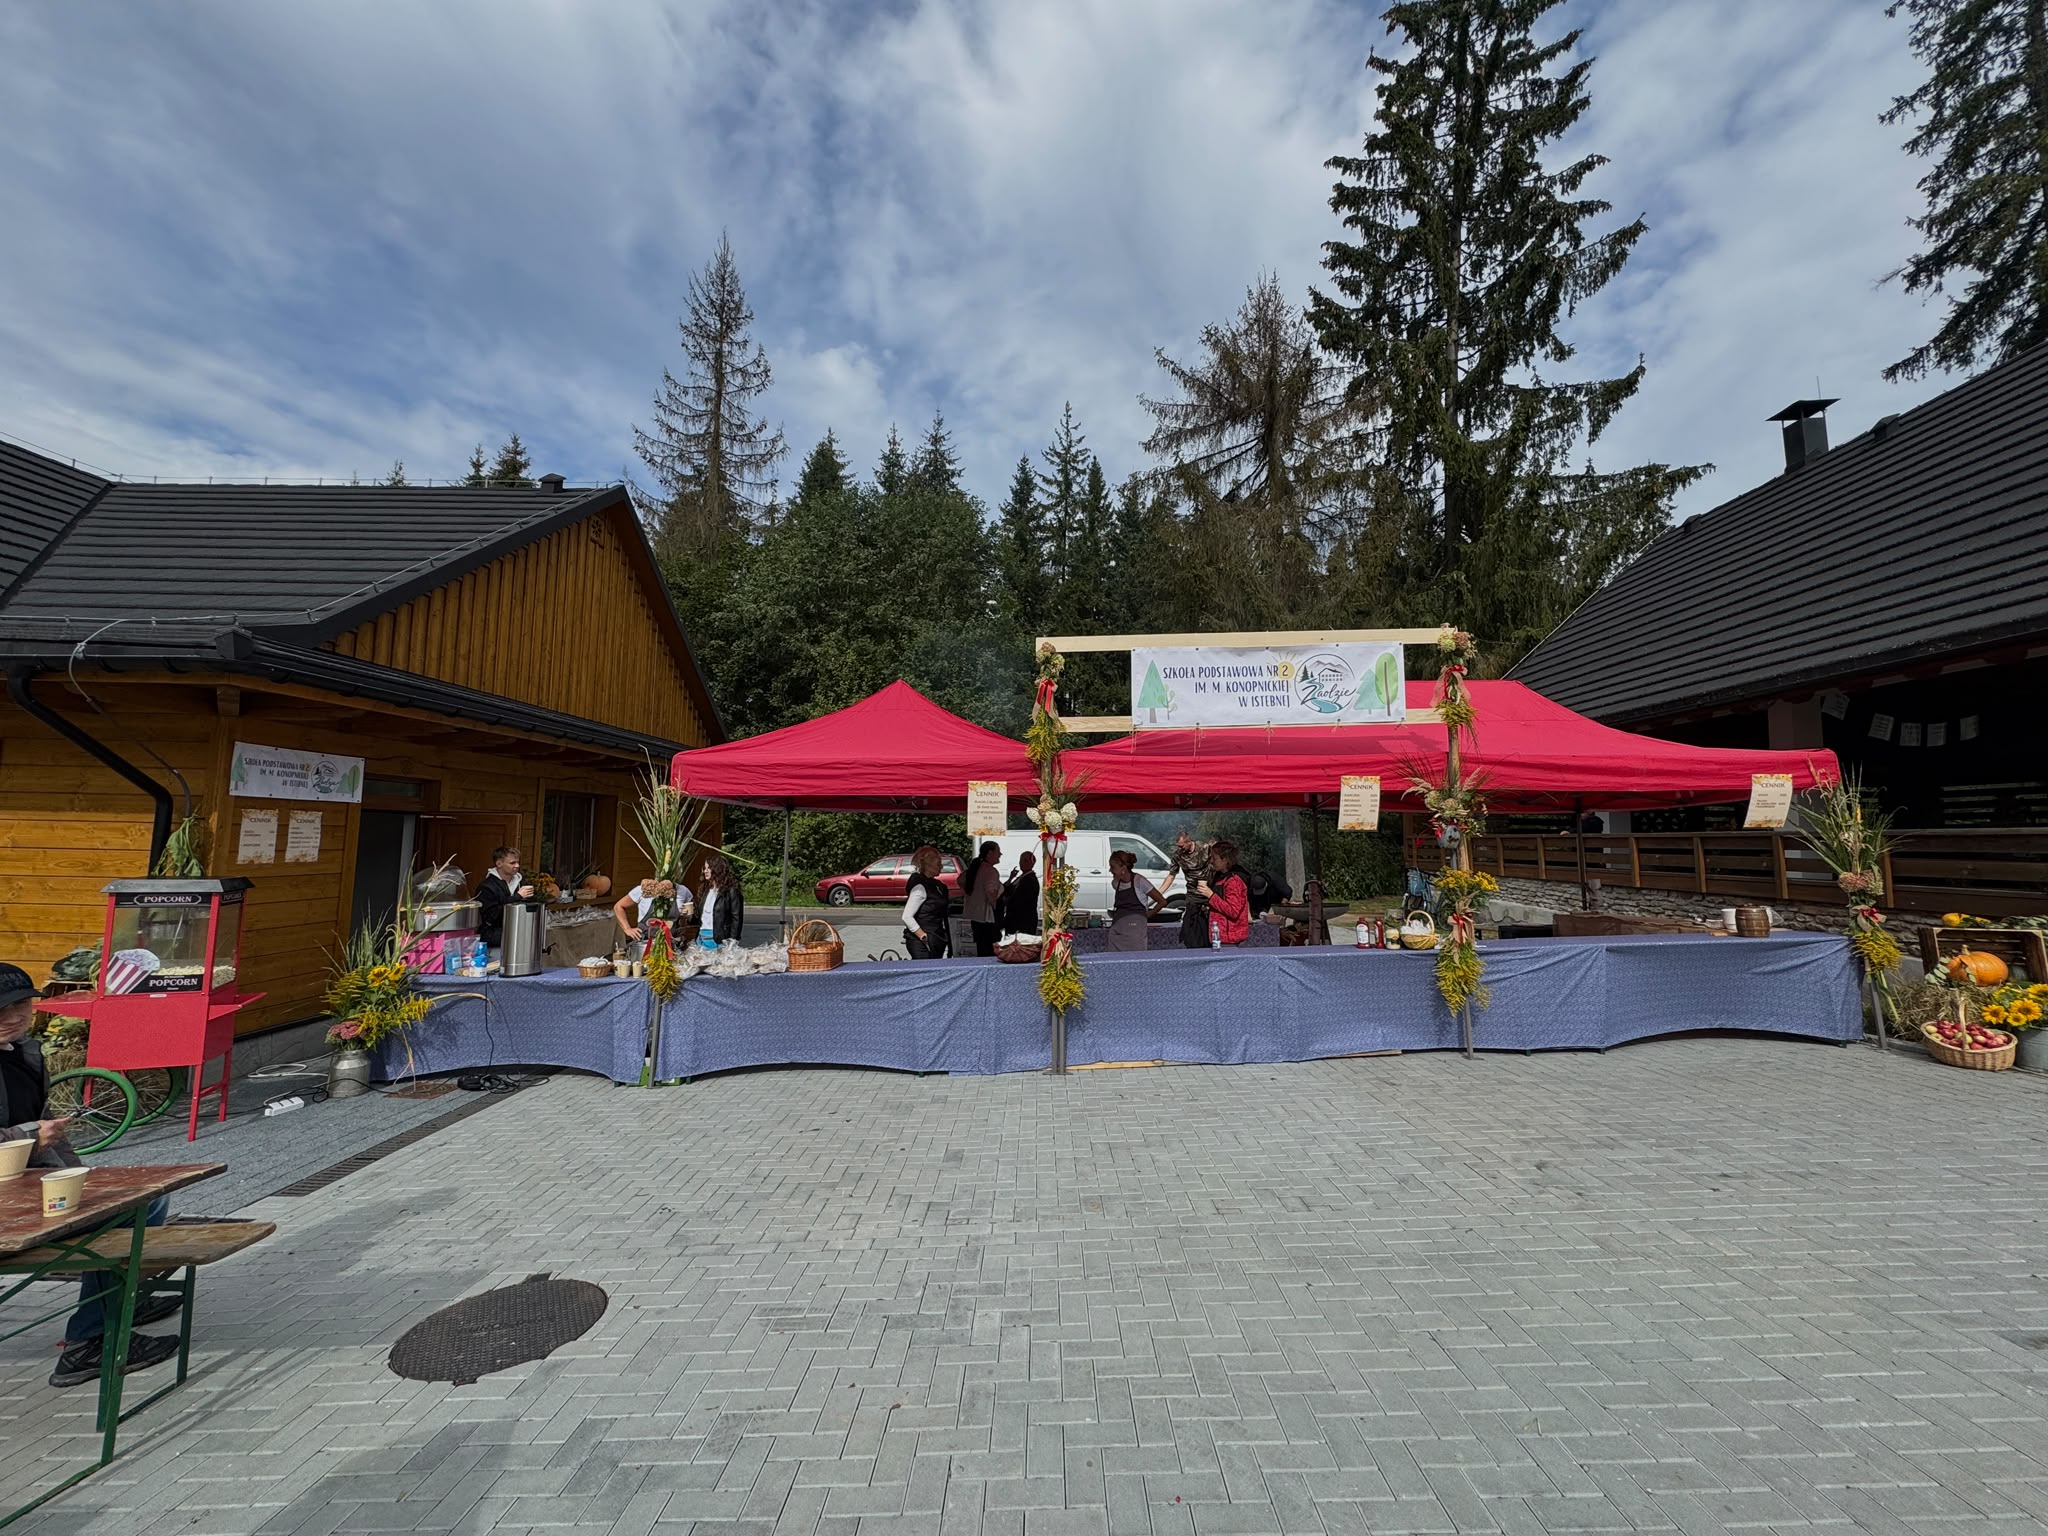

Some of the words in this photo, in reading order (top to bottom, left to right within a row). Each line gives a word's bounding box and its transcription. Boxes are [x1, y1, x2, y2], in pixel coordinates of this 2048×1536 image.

[1163, 666, 1196, 679] SZKOŁA
[1198, 665, 1264, 679] PODSTAWOWA
[1266, 664, 1279, 677] NR
[1282, 664, 1289, 677] 2
[1226, 679, 1290, 693] KONOPNICKIEJ
[1239, 695, 1248, 707] W
[1251, 694, 1290, 708] ISTEBNEJ
[1300, 683, 1357, 706] Zaolzie
[144, 895, 192, 903] POPCORN
[149, 978, 198, 987] POPCORN
